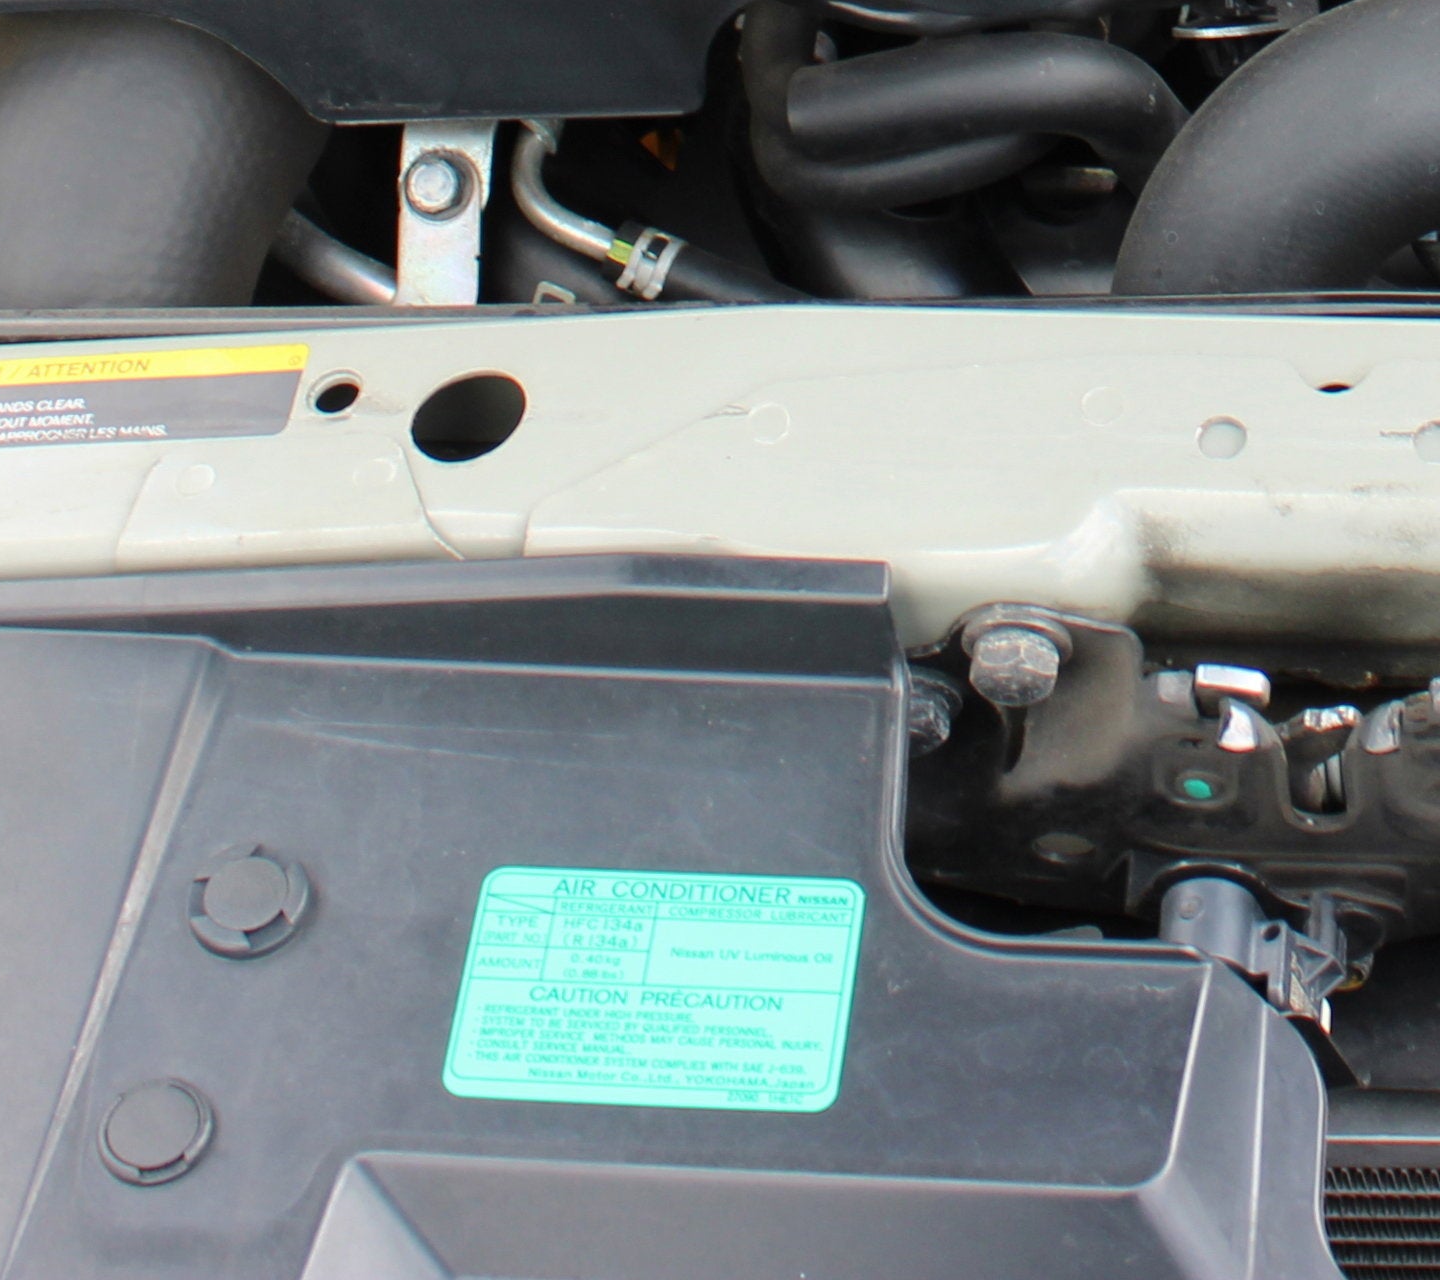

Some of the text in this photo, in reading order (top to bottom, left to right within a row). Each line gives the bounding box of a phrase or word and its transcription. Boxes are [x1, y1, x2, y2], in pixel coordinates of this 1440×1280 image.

[27, 358, 152, 379] ATTENTION
[88, 426, 118, 439] LES
[552, 878, 793, 904] AIR CONDITIONER
[559, 900, 655, 915] REFRIGERANT
[796, 894, 848, 906] NISSAN
[496, 914, 539, 929] TYPE
[667, 905, 848, 923] COMPRESSOR LUBRICANT
[477, 956, 542, 971] AMOUNT
[669, 946, 835, 965] Nissan UV Luminous Oil
[528, 985, 784, 1012] CAUTION PRÉCAUTION
[484, 1004, 560, 1017] REFRIGERANT
[563, 1007, 602, 1018] UNDER
[603, 1009, 632, 1020] HIGH
[481, 1015, 526, 1027] SYSTEM
[530, 1017, 546, 1028] TO
[548, 1018, 564, 1028] BE
[566, 1019, 622, 1030] SERVICED
[624, 1021, 640, 1031] BY
[642, 1022, 701, 1035] QUALIFIED
[476, 1038, 529, 1050] CONSULT
[533, 1040, 578, 1052] SERVICE
[479, 1027, 535, 1039] IMPROPER
[539, 1029, 585, 1041] SERVICE
[592, 1032, 647, 1044] METHODS
[650, 1034, 674, 1045] MAY
[677, 1035, 718, 1047] CAUSE
[719, 1037, 777, 1050] PERSONAL
[475, 1050, 500, 1062] THIS
[502, 1052, 522, 1063] AIR
[525, 1053, 600, 1066] CONDITIONER
[603, 1056, 648, 1068] SYSTEM
[651, 1058, 707, 1071] COMPLIES
[710, 1061, 740, 1072] WITH
[742, 1062, 765, 1074] SAE
[528, 1067, 573, 1079] Nissan
[576, 1069, 616, 1081] Motor
